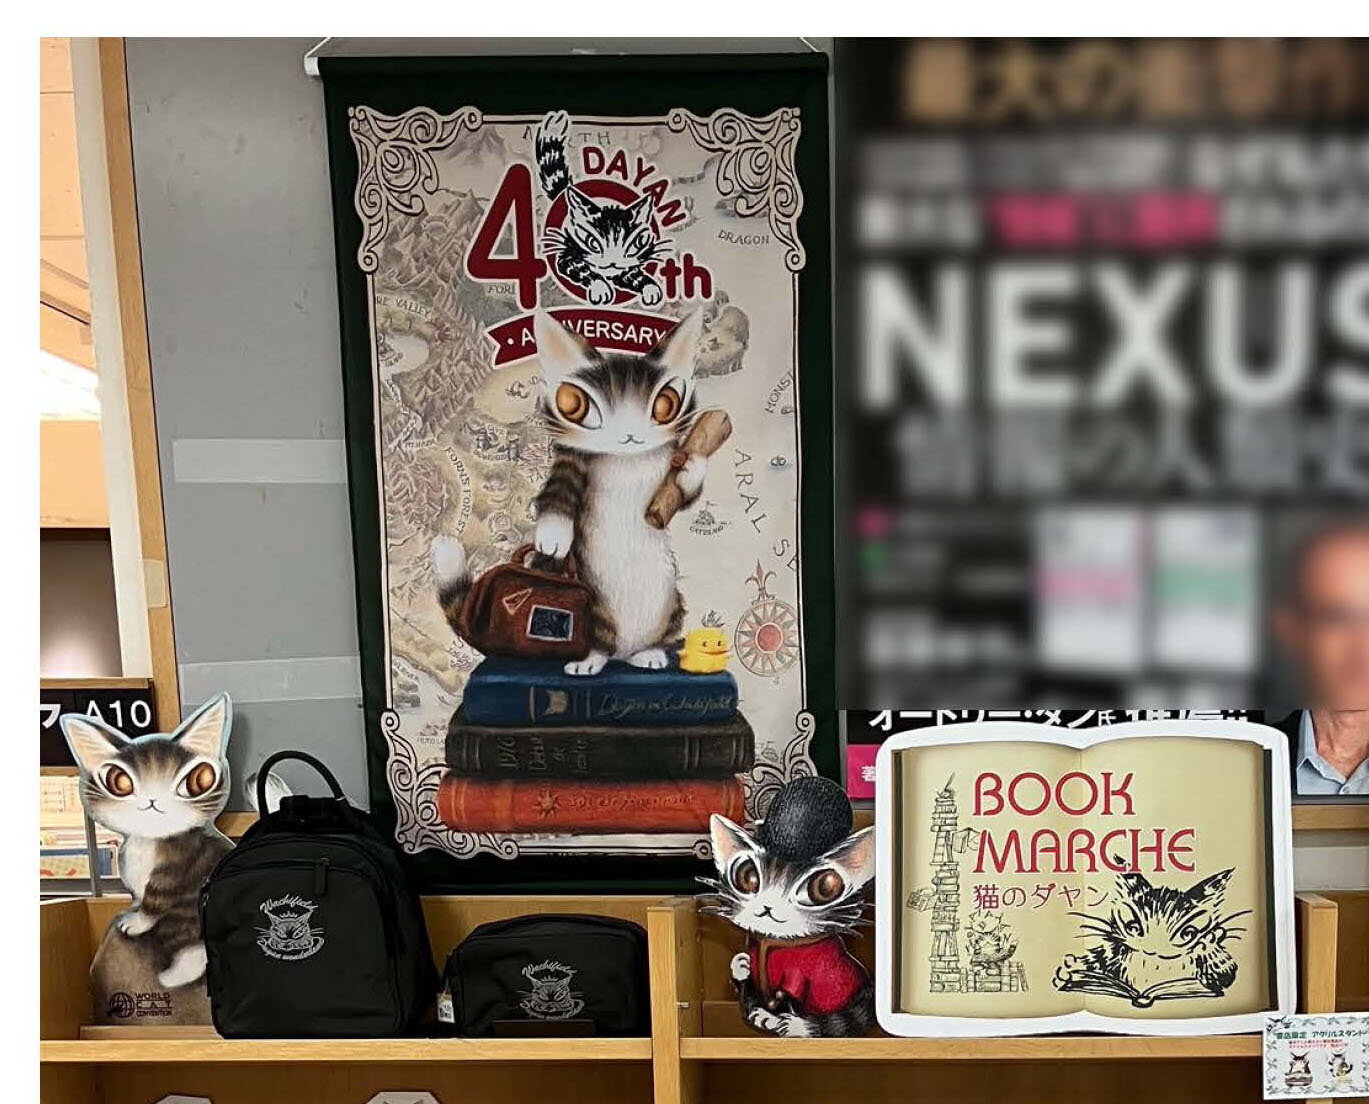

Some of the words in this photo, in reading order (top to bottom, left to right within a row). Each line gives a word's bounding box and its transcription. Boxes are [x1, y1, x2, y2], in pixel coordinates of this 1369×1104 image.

[582, 145, 687, 229] DAYAN
[521, 318, 668, 348] AVERSARY
[734, 447, 762, 534] ARAL
[86, 699, 153, 728] A10
[972, 771, 1137, 816] BOOK
[972, 828, 1196, 874] MARCHE
[973, 884, 1110, 912] 猫のダヤン
